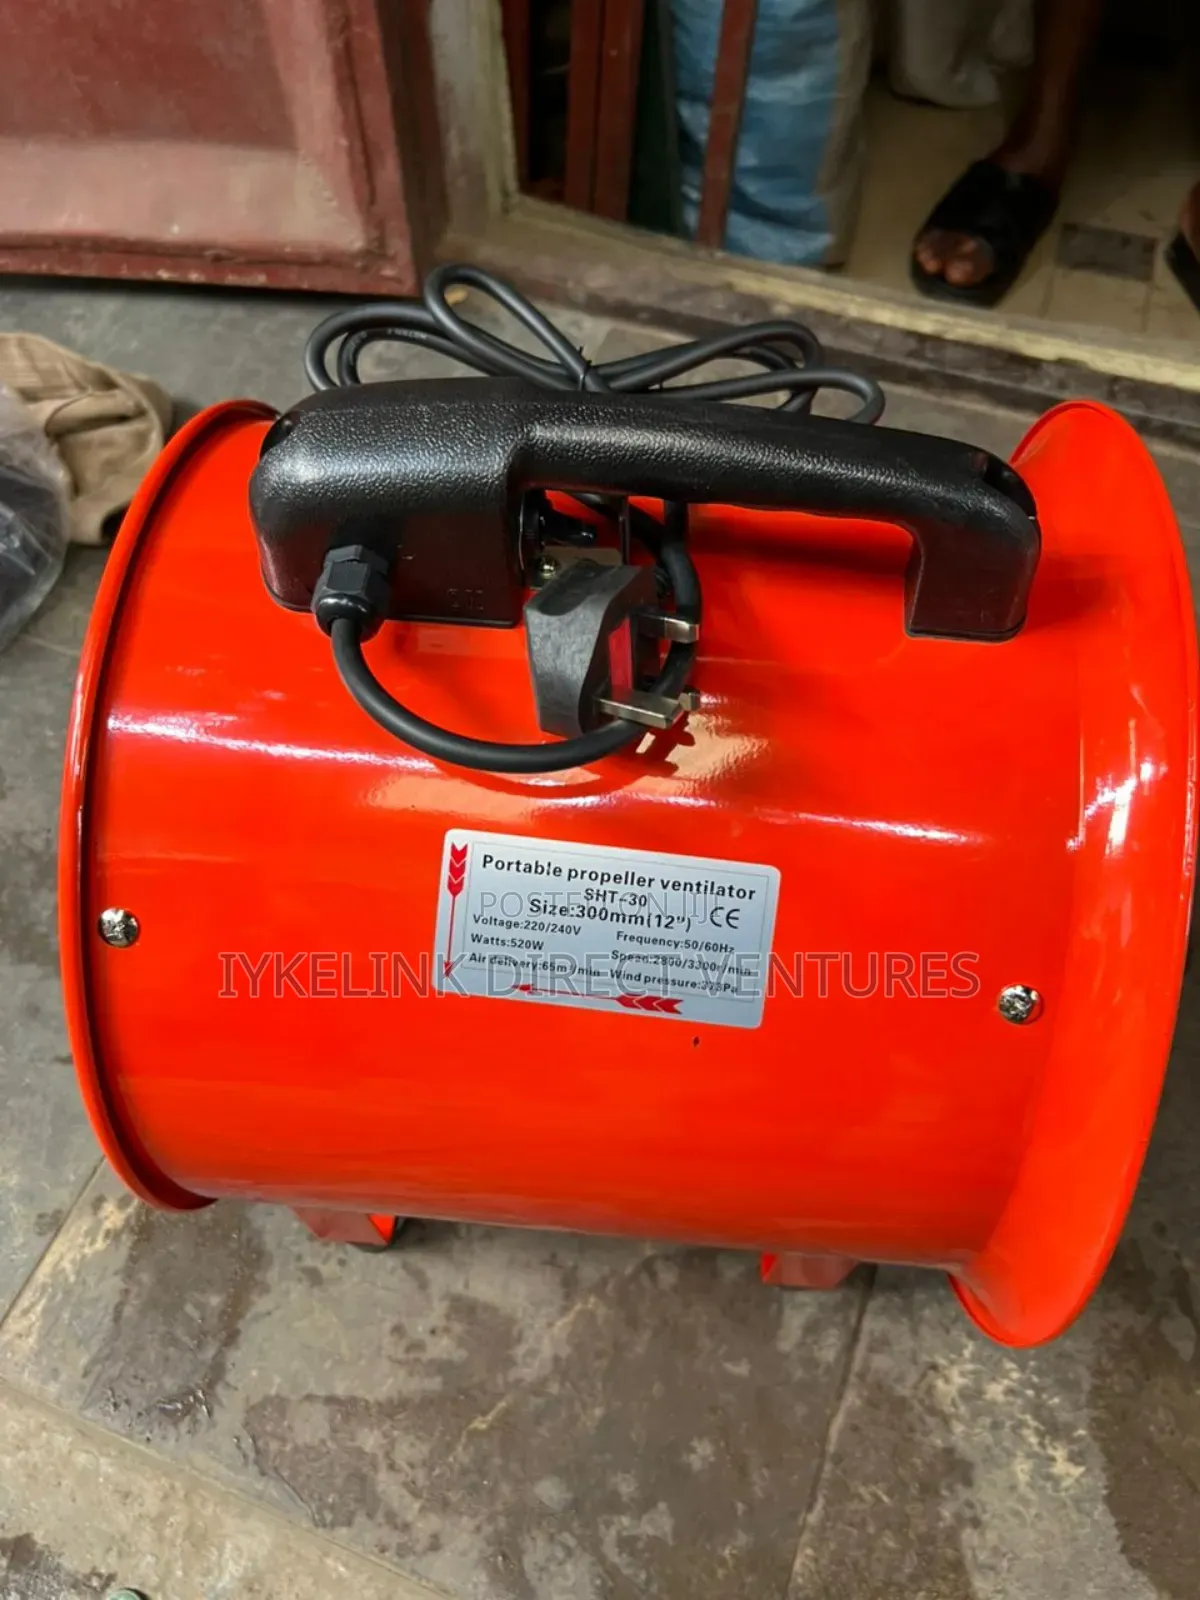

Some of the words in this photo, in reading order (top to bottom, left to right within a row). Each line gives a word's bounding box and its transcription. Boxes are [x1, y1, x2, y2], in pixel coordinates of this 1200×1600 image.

[482, 854, 562, 877] Portable
[567, 866, 656, 888] propeller
[661, 878, 756, 901] ventilator
[584, 888, 648, 908] SHT-30
[473, 914, 581, 936] Voltage:220/240V
[710, 907, 740, 929] CE
[471, 934, 544, 950] Watts:520W
[616, 931, 735, 954] Frequency:50/60Hz
[469, 953, 486, 964] Air
[610, 969, 642, 982] Wind
